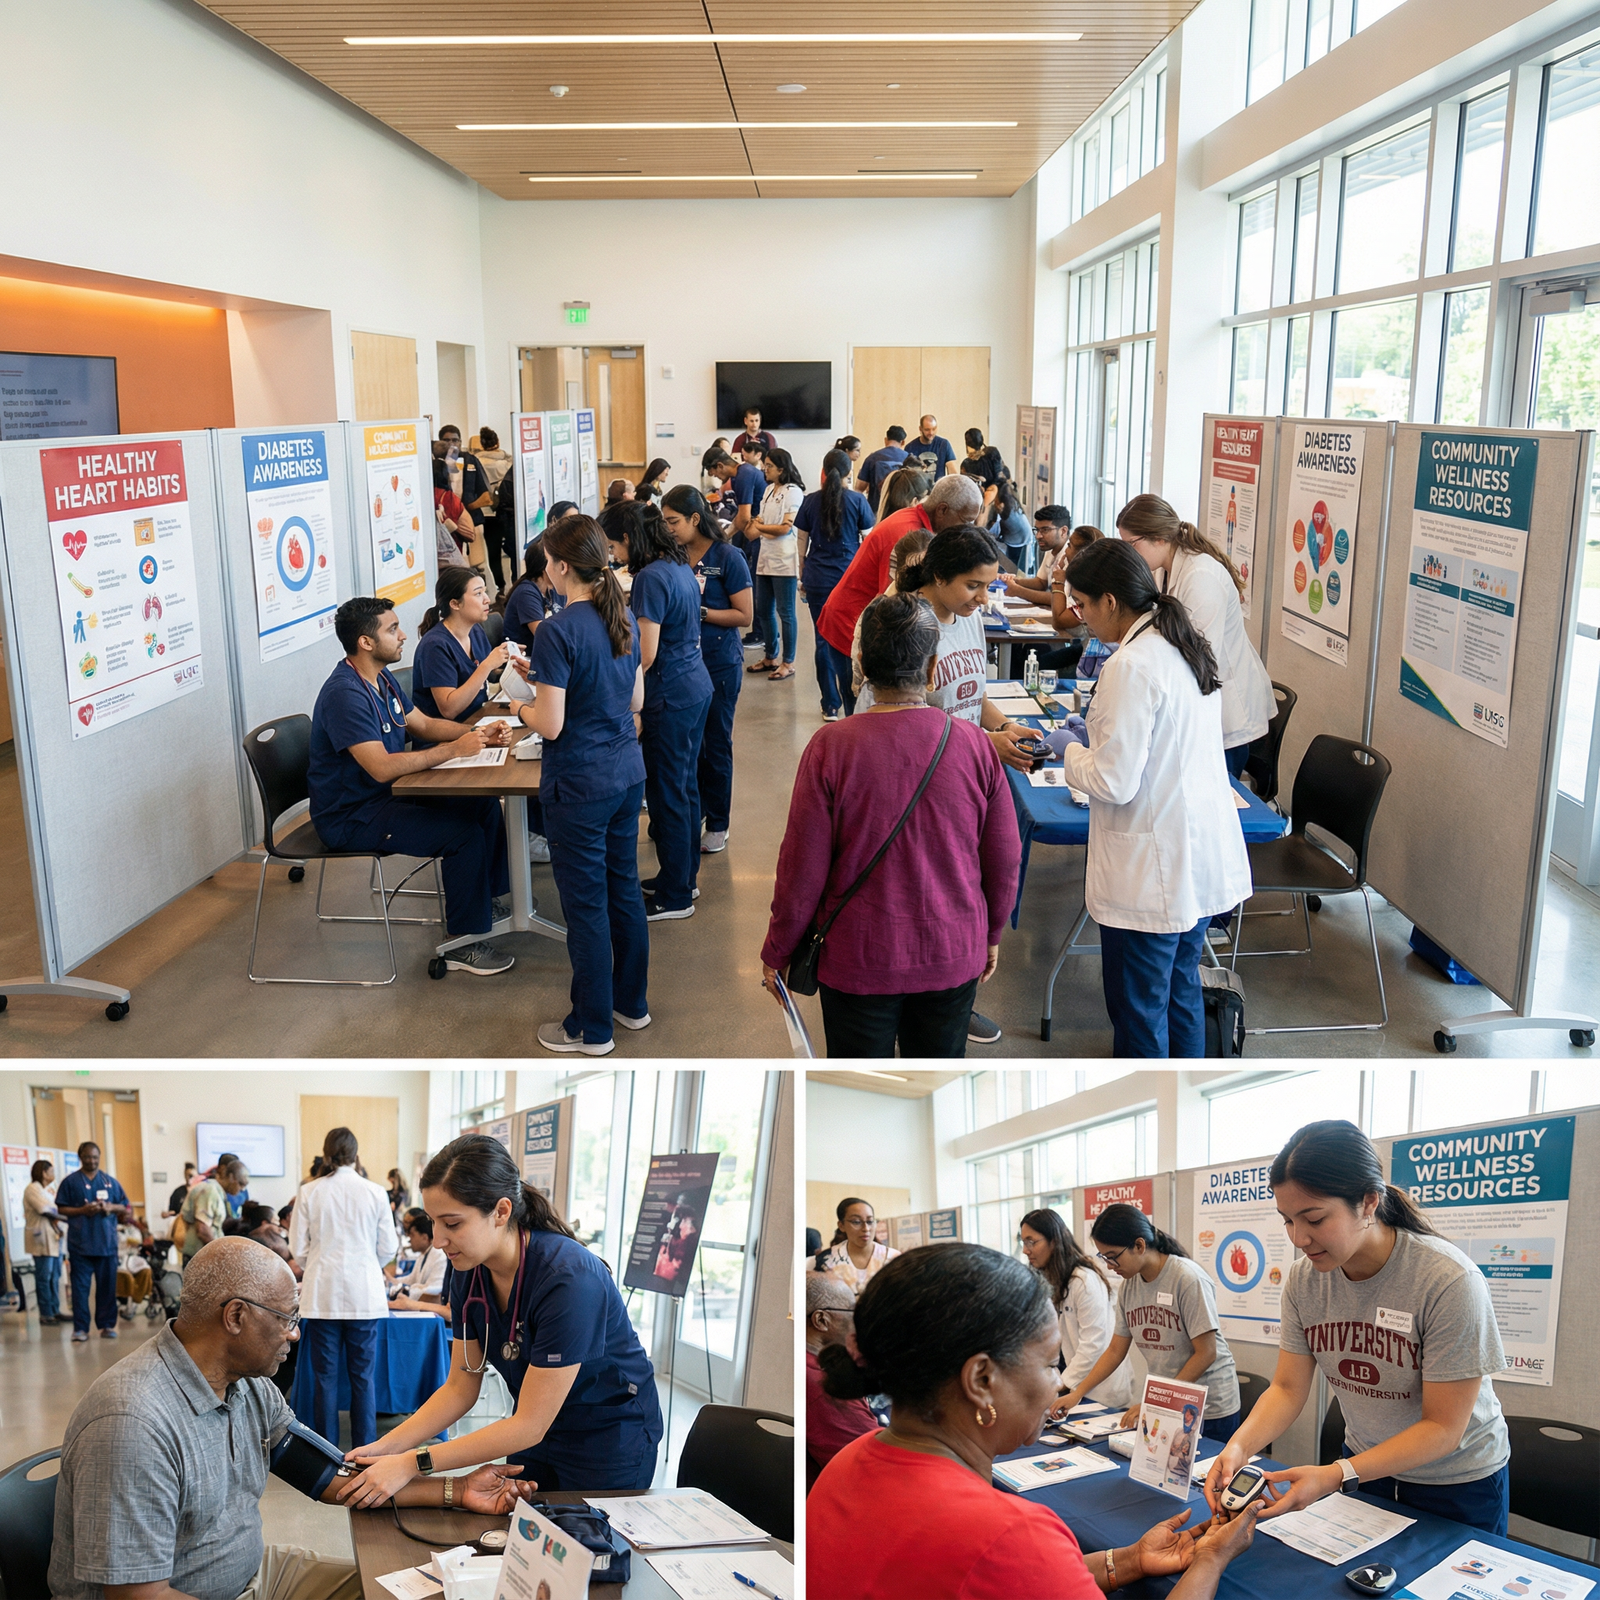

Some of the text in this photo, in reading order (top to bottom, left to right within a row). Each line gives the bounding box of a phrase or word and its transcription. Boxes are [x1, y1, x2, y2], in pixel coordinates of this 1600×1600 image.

[257, 438, 314, 461] DIABETES
[1304, 431, 1352, 452] DIABETES
[1431, 440, 1520, 467] COMMUNITY
[77, 450, 157, 479] HEALTHY
[252, 458, 323, 484] AWARENESS
[1296, 451, 1357, 475] AWARENESS
[1435, 463, 1510, 492] WELLNESS
[54, 473, 181, 511] HEART HABITS
[1429, 486, 1512, 518] RESOURCES
[1408, 1127, 1548, 1162] COMMUNITY
[1414, 1153, 1535, 1182] WELLNESS
[1201, 1185, 1275, 1205] AWARENES
[1408, 1175, 1541, 1203] RESOURCES
[1304, 1321, 1420, 1370] UNIVERSITY
